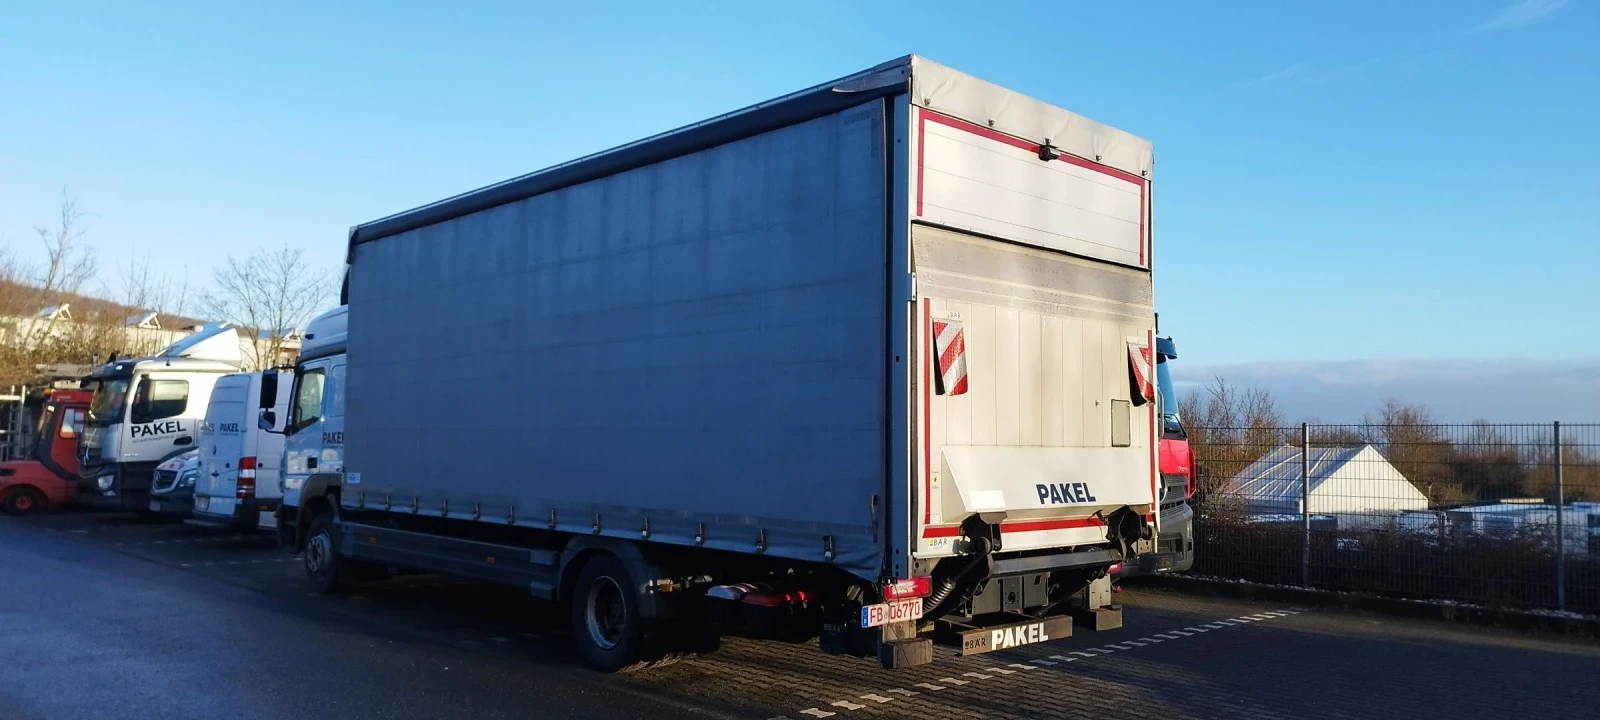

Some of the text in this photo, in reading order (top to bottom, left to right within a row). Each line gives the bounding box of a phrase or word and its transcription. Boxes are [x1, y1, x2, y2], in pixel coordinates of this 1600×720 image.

[131, 421, 187, 438] PAKEL
[220, 423, 239, 432] PAKEL
[1036, 483, 1096, 504] PAKEL
[870, 607, 882, 623] FB
[970, 638, 986, 649] BÄR
[992, 622, 1048, 650] PAKEL
